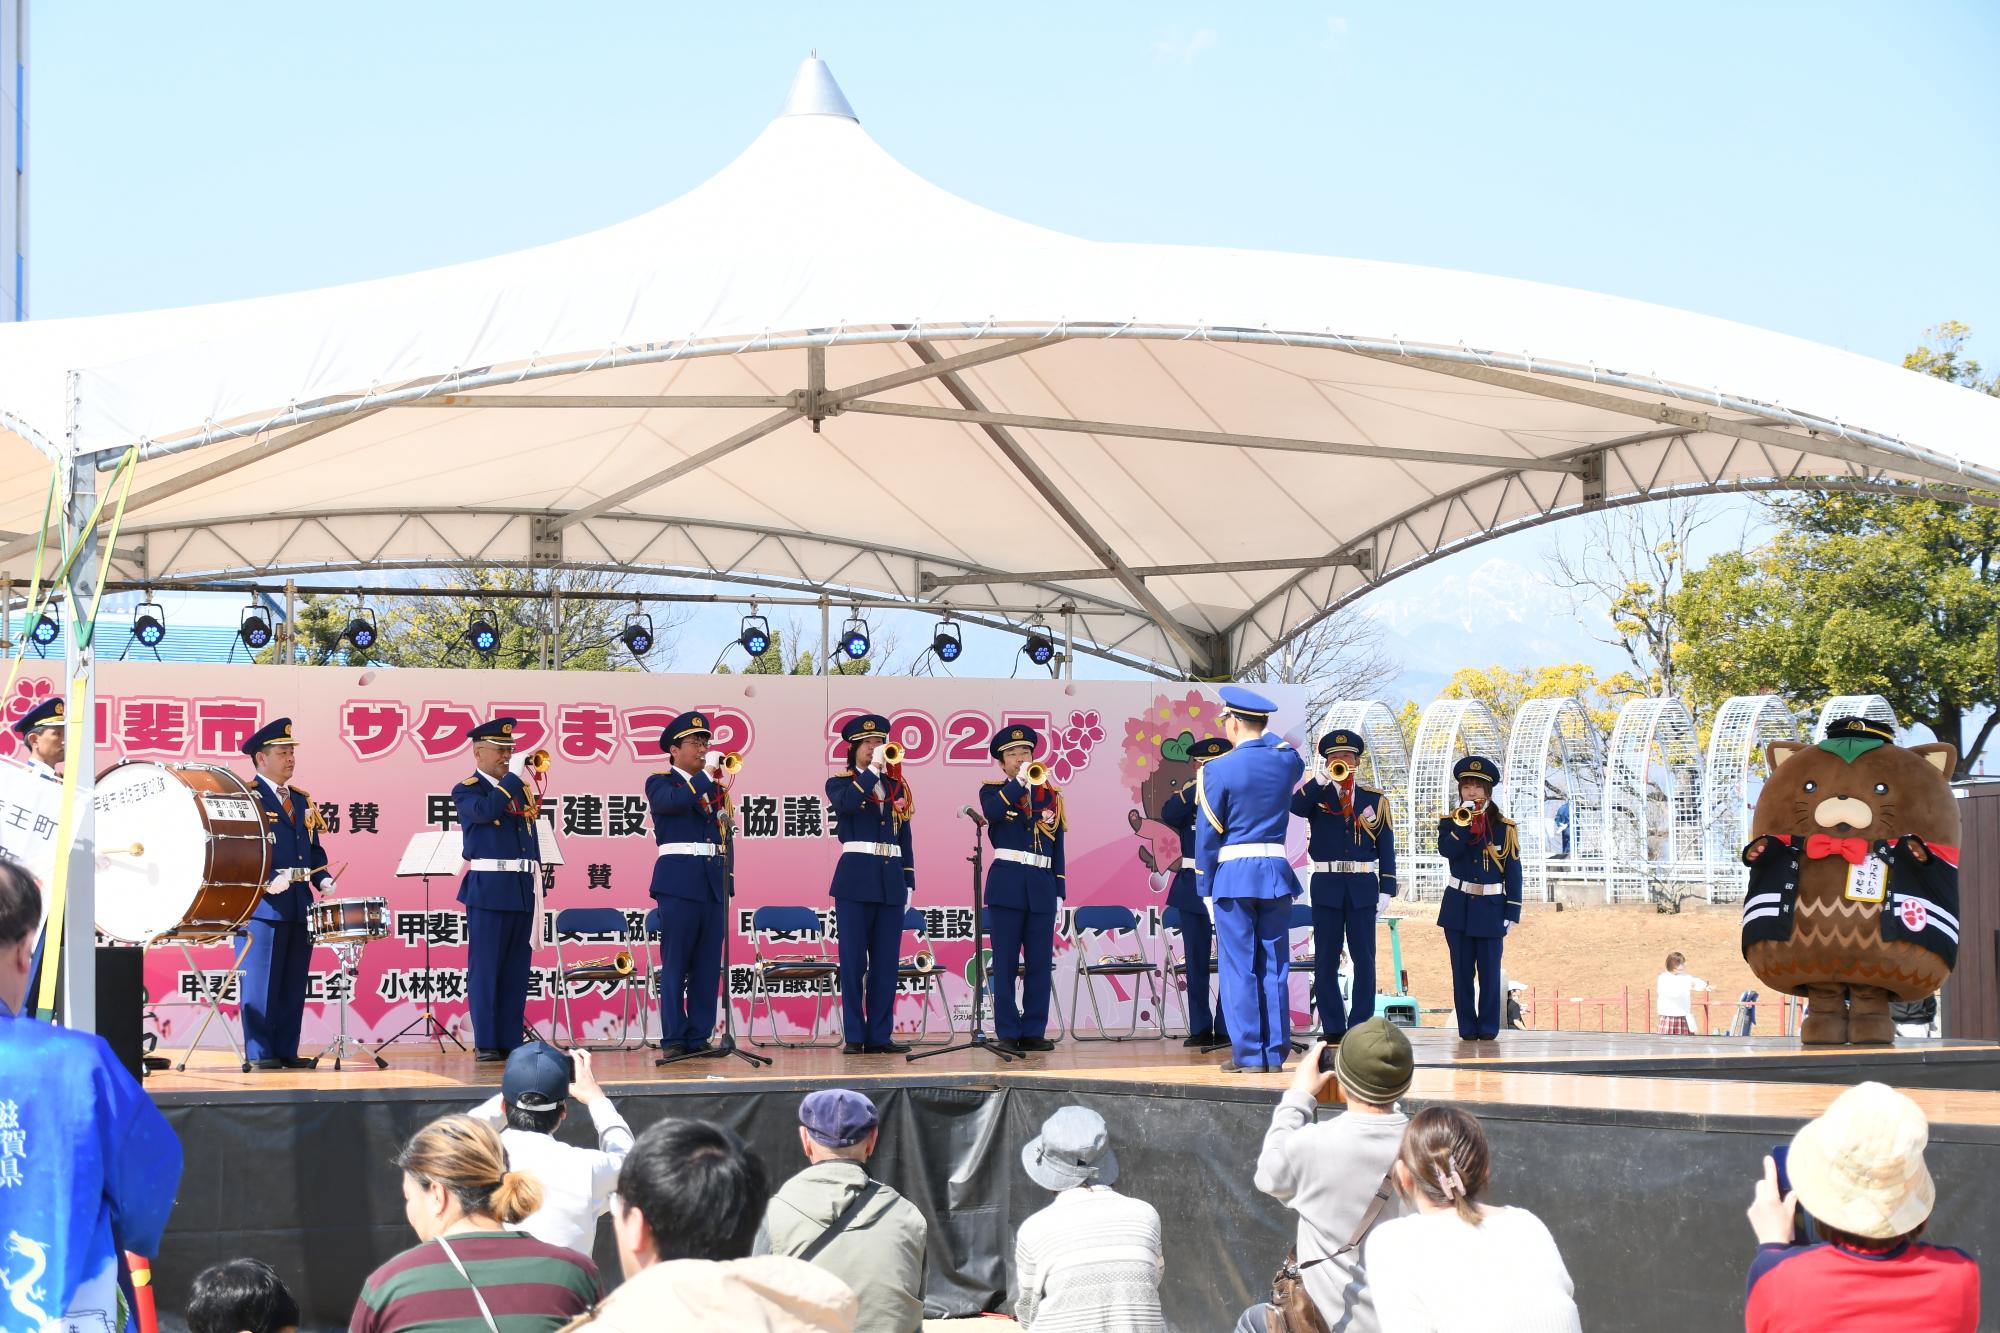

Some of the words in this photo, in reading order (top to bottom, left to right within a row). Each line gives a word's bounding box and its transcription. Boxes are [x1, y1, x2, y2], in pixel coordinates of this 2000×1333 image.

[346, 705, 750, 757] サクラまつり
[0, 799, 59, 840] 王町
